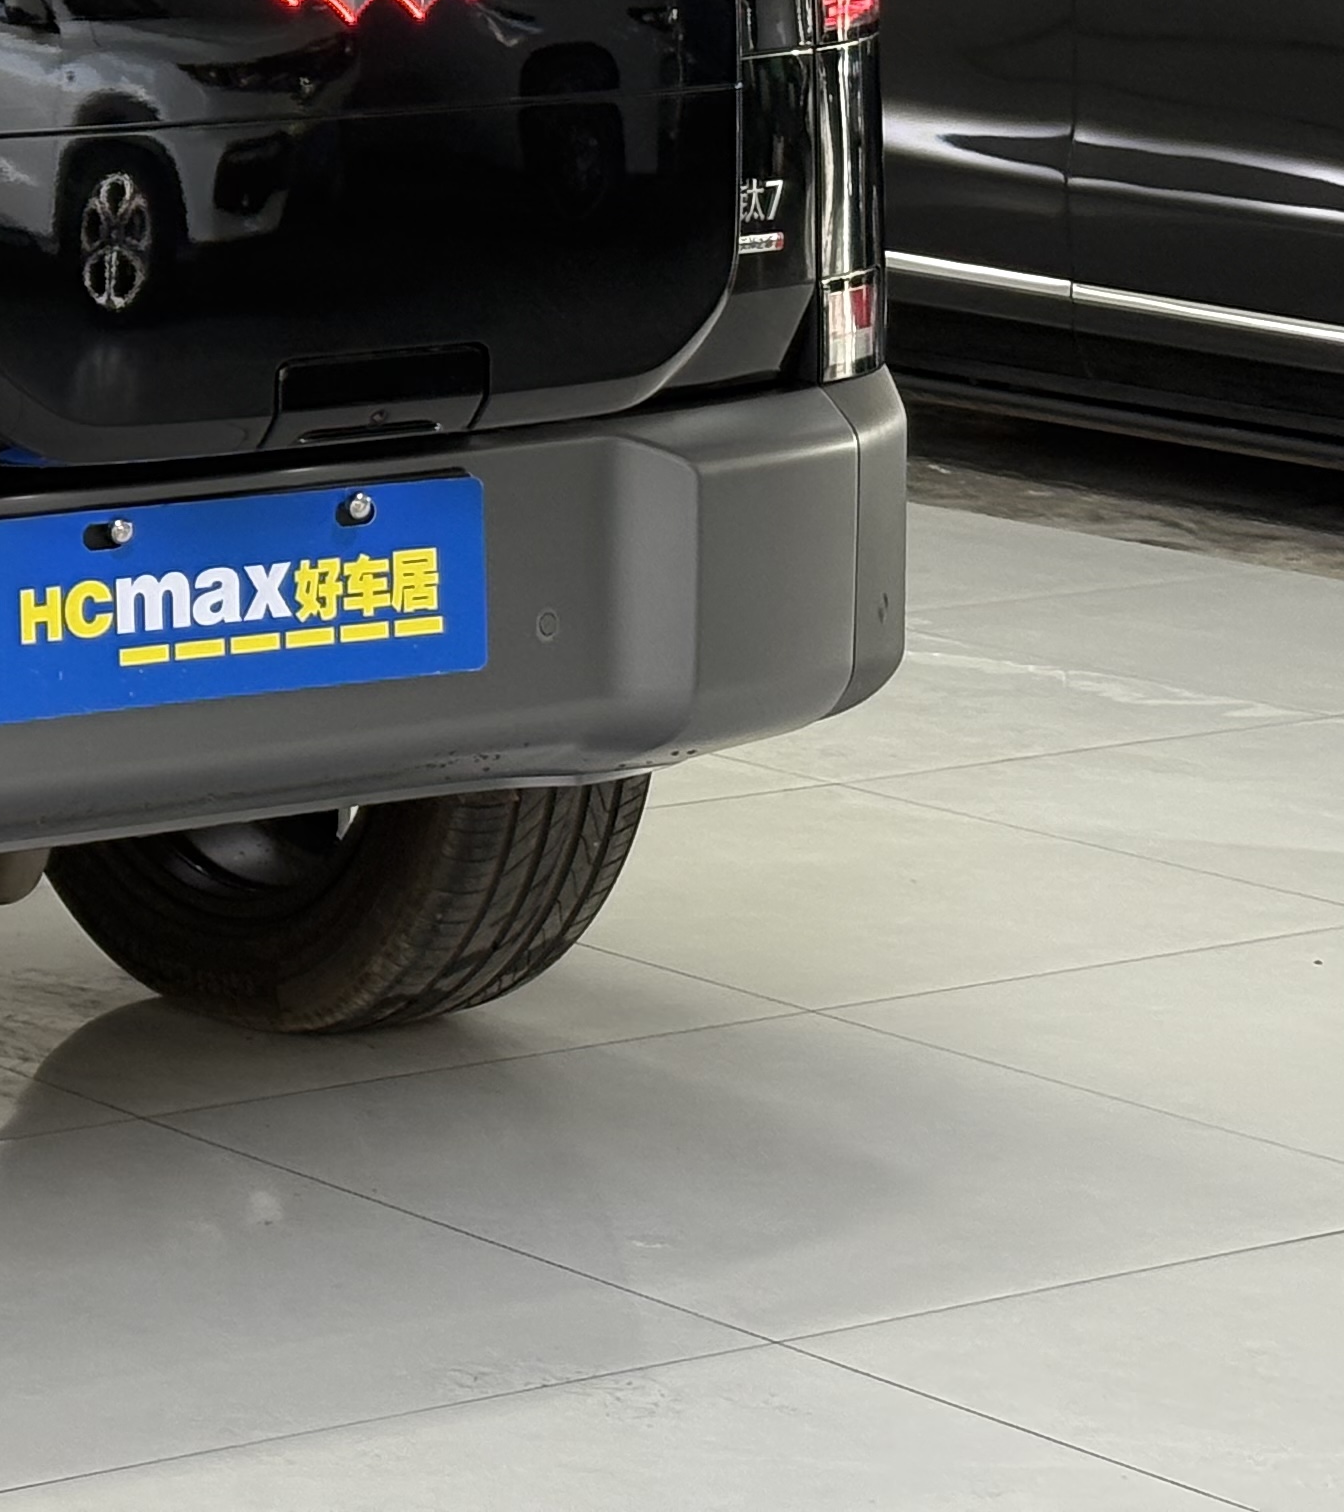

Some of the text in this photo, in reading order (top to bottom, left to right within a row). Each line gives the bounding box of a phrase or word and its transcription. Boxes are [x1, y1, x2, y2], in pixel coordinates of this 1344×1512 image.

[18, 546, 442, 646] HCmax 好车居
